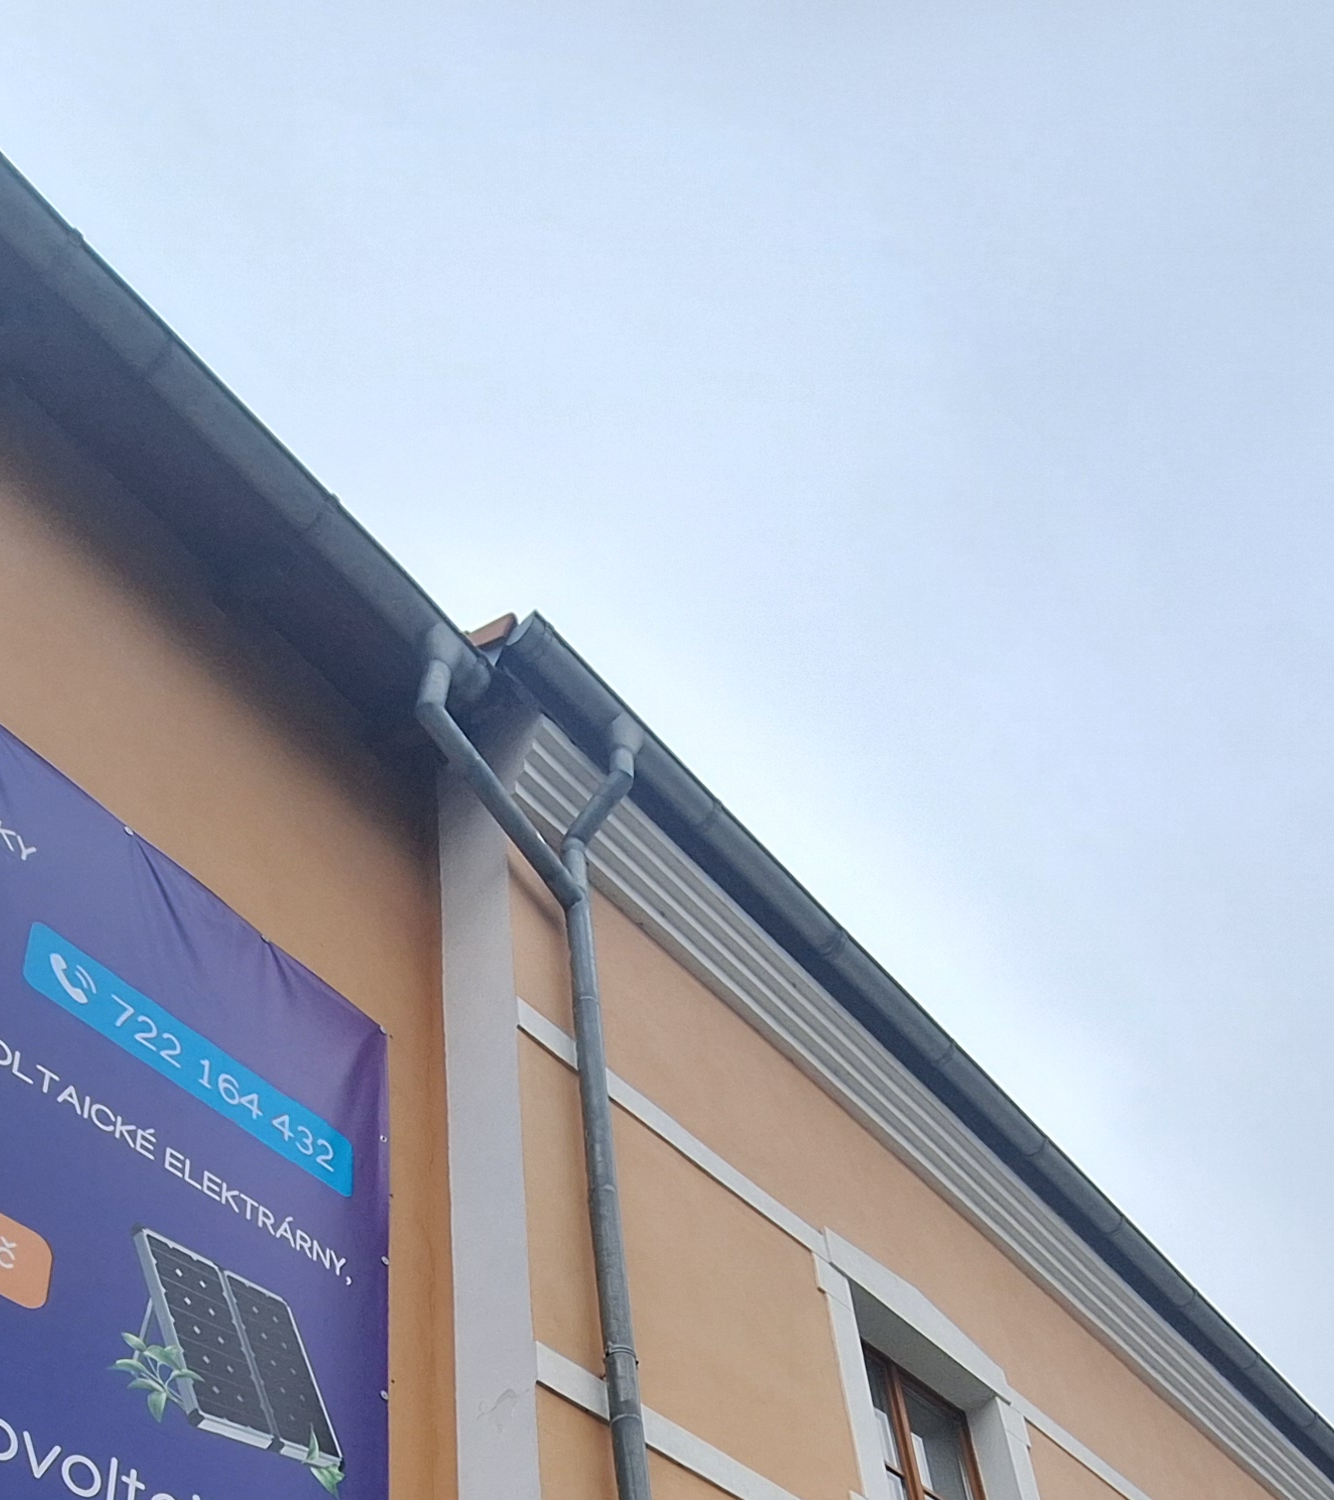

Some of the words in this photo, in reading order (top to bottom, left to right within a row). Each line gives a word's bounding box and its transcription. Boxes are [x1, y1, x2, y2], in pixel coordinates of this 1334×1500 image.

[111, 994, 182, 1069] 722
[198, 1058, 263, 1119] 164
[272, 1114, 335, 1173] 432
[164, 1146, 353, 1286] ELEKTRÁRNY,
